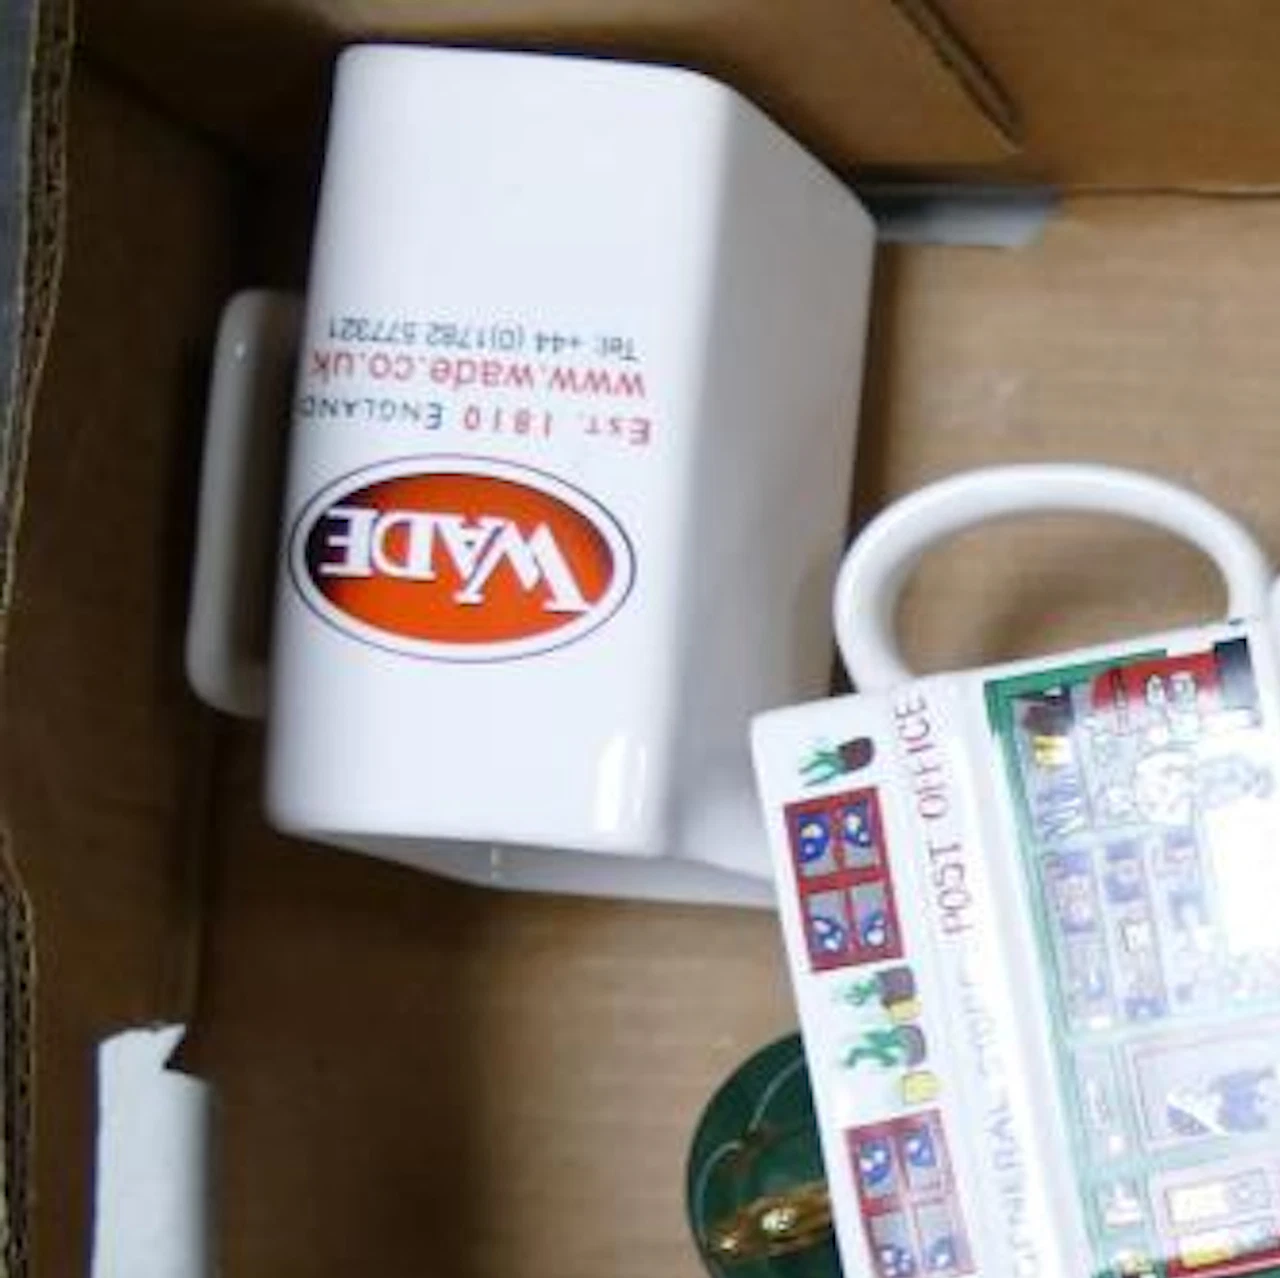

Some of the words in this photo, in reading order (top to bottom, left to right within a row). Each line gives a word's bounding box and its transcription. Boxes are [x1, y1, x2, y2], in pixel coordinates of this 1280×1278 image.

[328, 317, 417, 342] 577321
[425, 323, 524, 348] (0)1782
[536, 330, 581, 351] +44
[598, 335, 639, 360] Tel:
[310, 350, 647, 398] www.wade.co.uk
[462, 405, 554, 437] 1810
[320, 506, 595, 613] WADE
[929, 840, 974, 935] POST
